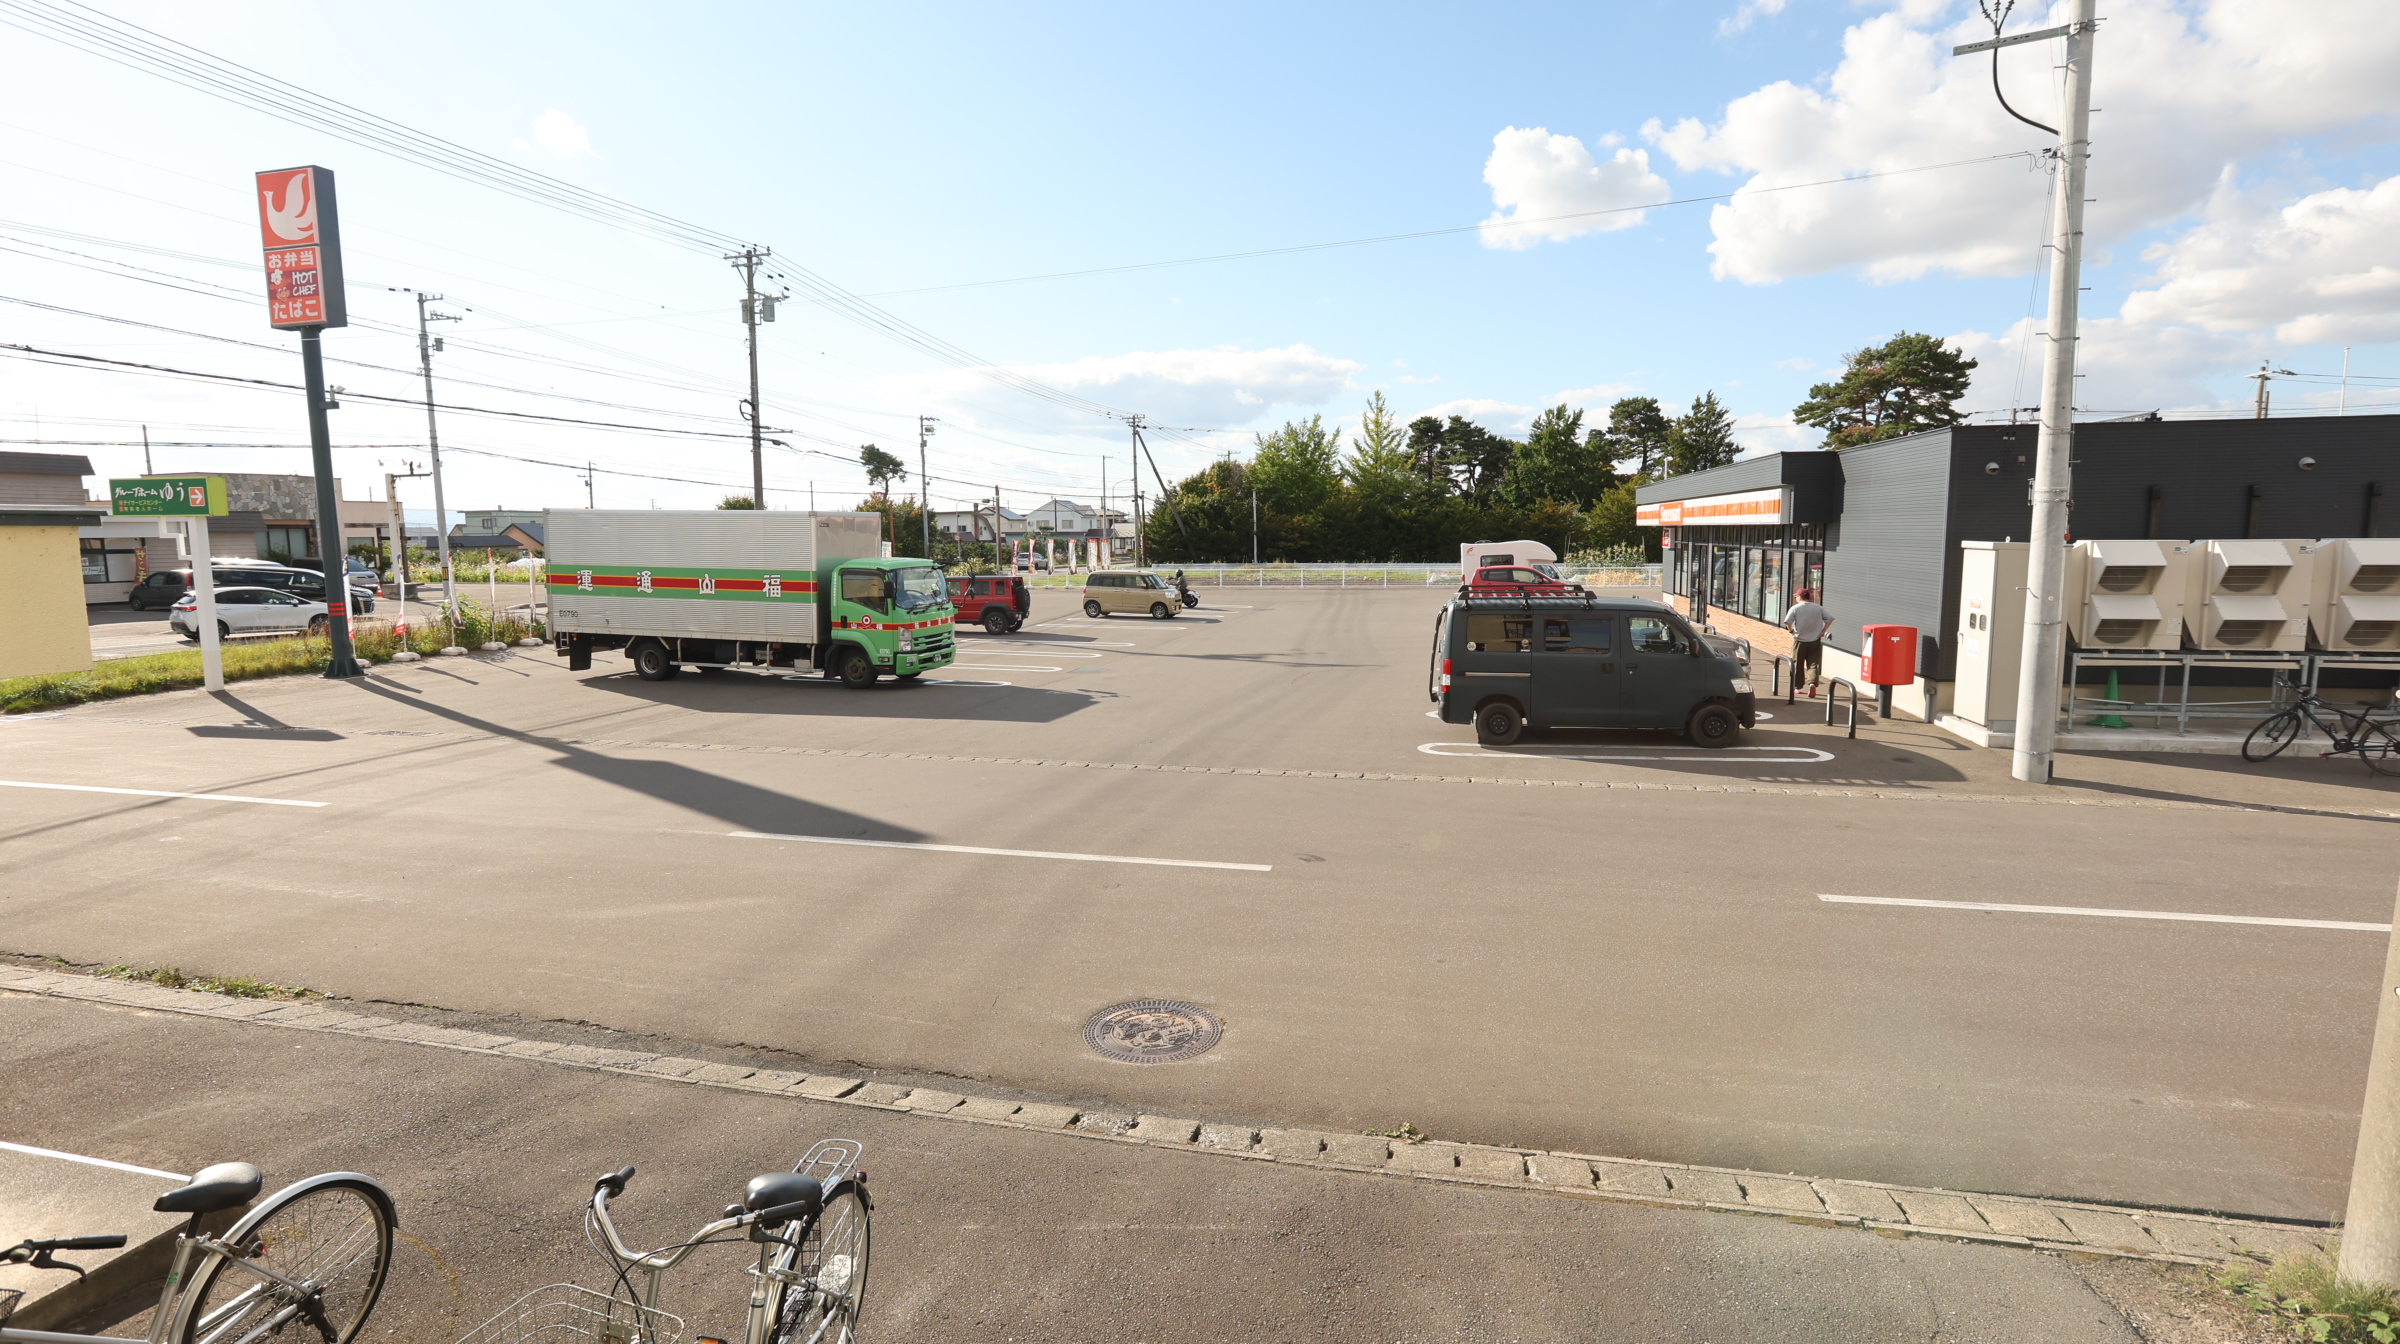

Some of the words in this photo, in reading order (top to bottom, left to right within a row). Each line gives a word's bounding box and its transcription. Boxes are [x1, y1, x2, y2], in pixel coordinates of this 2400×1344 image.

[268, 250, 314, 269] お弁当
[292, 271, 317, 285] HOT
[292, 284, 317, 297] CHEF
[273, 299, 319, 320] たばこ
[115, 486, 158, 498] グループホーム
[159, 482, 185, 502] ゆう
